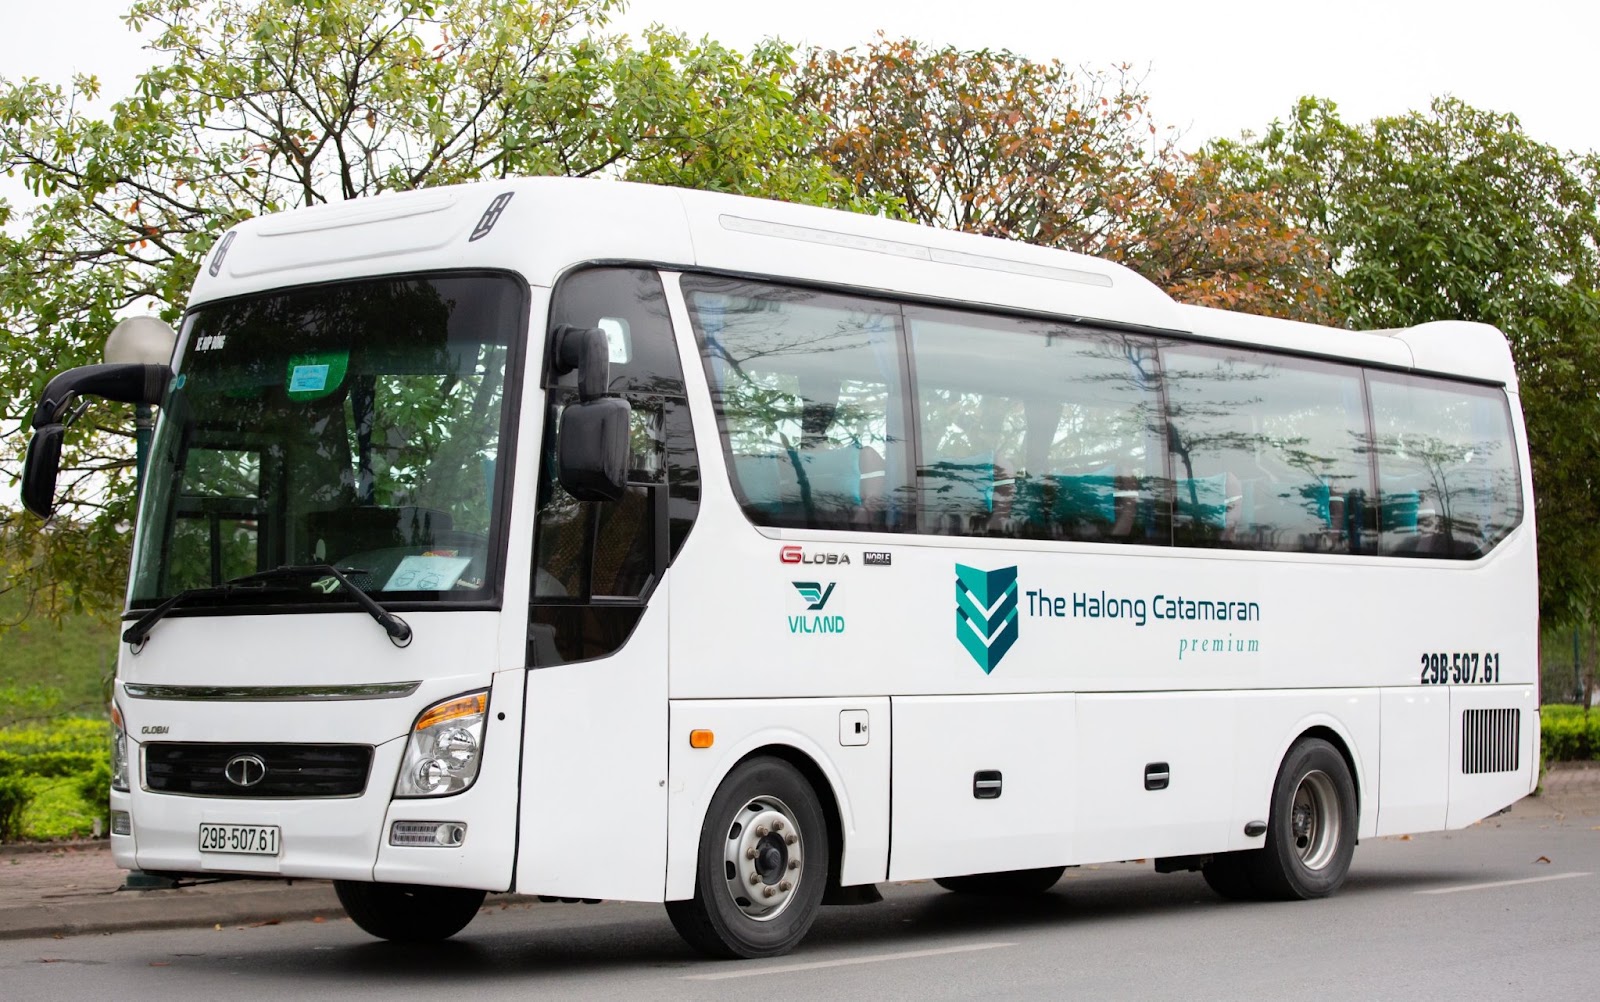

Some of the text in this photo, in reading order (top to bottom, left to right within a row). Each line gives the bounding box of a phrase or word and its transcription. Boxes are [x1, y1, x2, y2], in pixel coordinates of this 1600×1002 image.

[779, 545, 850, 565] GLOBA
[1026, 588, 1259, 626] The Halong Catamaran
[787, 615, 845, 634] VILAND
[1179, 633, 1259, 660] premium
[1421, 653, 1499, 684] 29B-507.61
[202, 827, 275, 852] 29B-507.61
